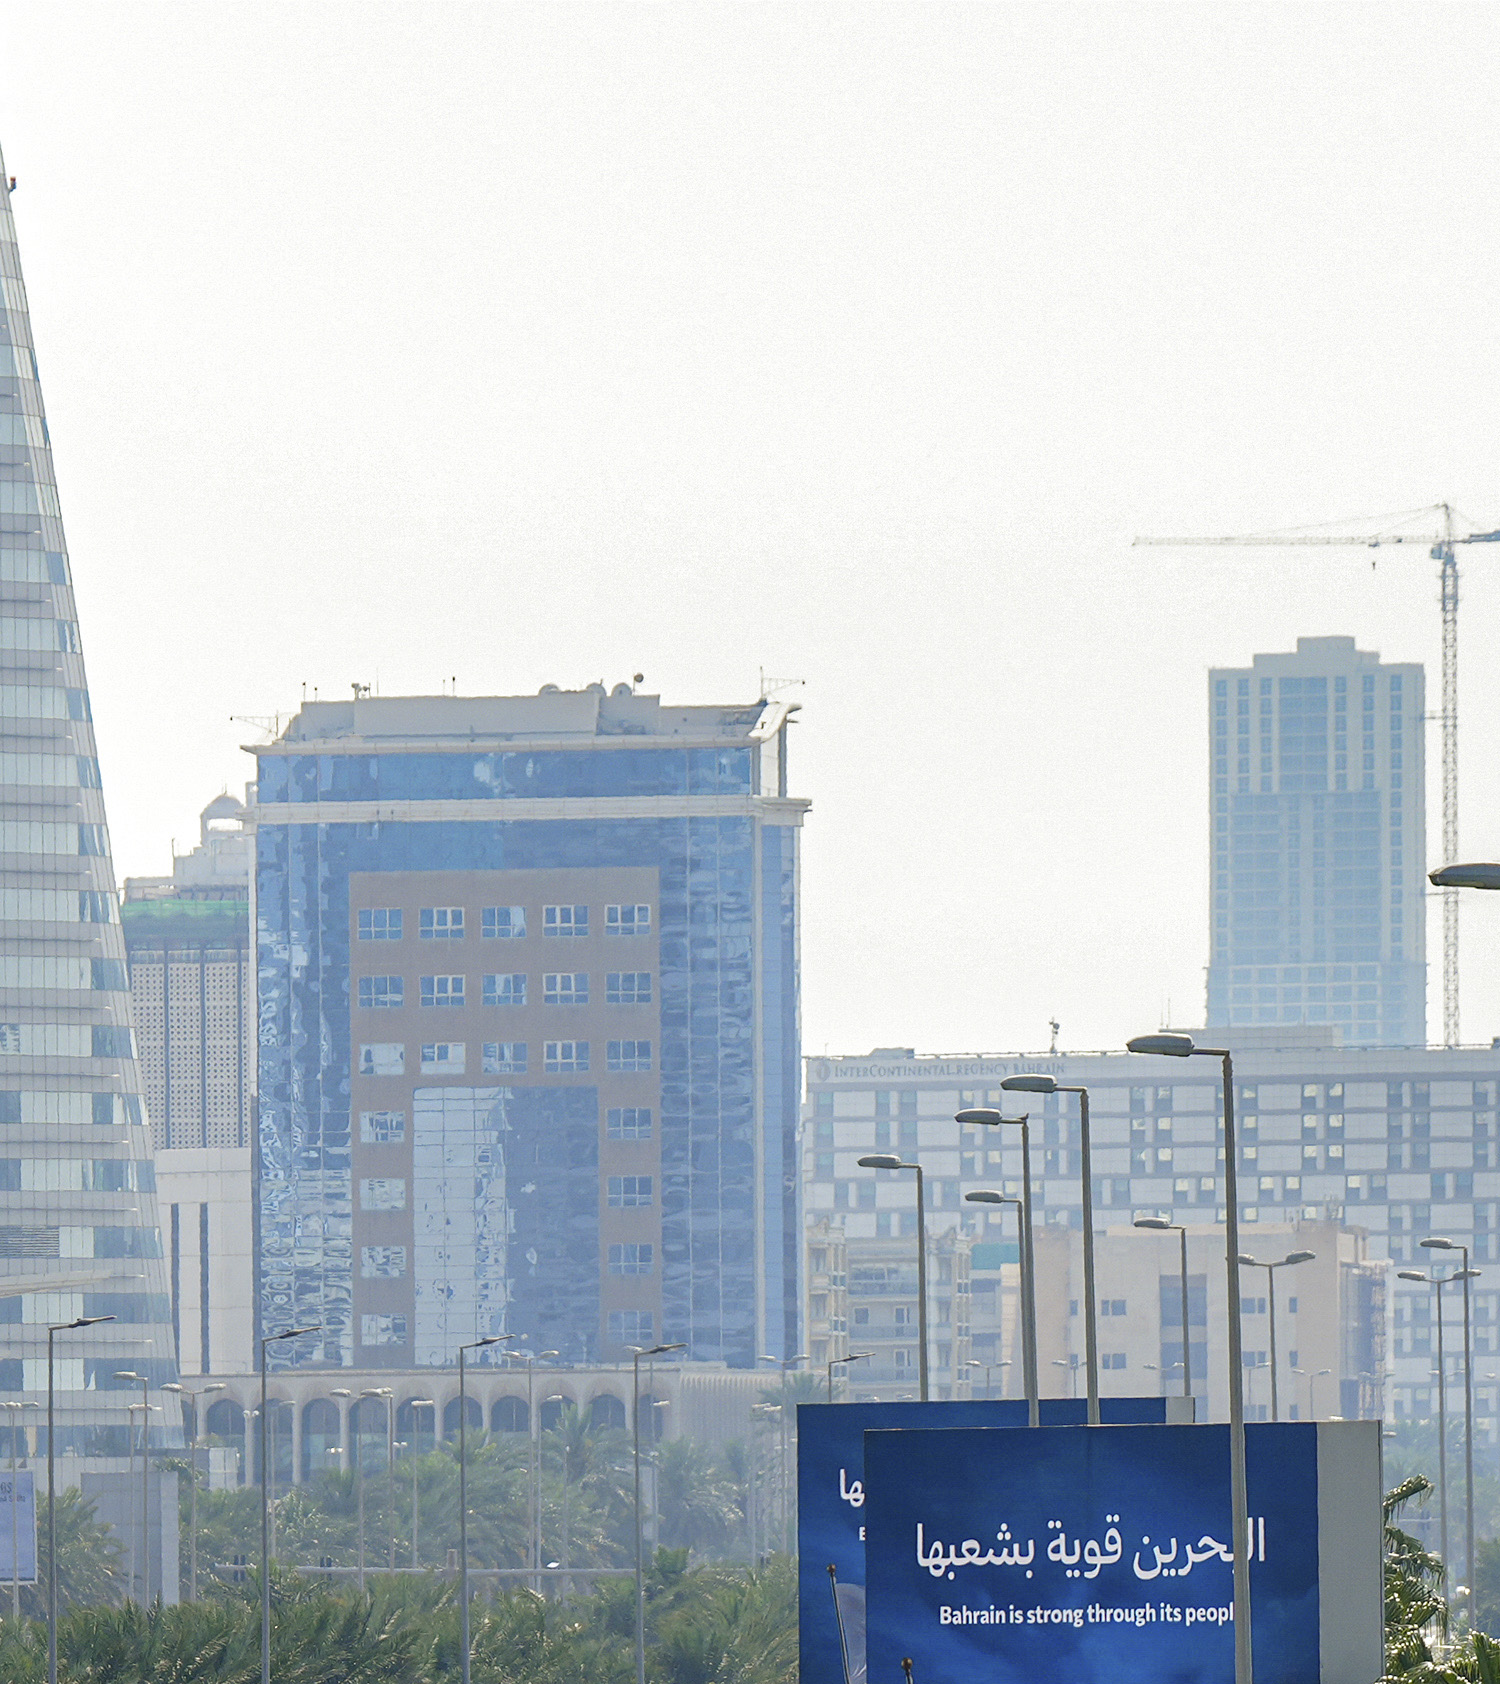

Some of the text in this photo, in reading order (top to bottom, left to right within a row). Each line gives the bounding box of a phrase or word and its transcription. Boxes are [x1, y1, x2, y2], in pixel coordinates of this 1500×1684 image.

[916, 1522, 1036, 1581] بشعبها
[1046, 1514, 1123, 1579] قوية
[940, 1602, 1235, 1628] Bahrain is strong through its peopl
